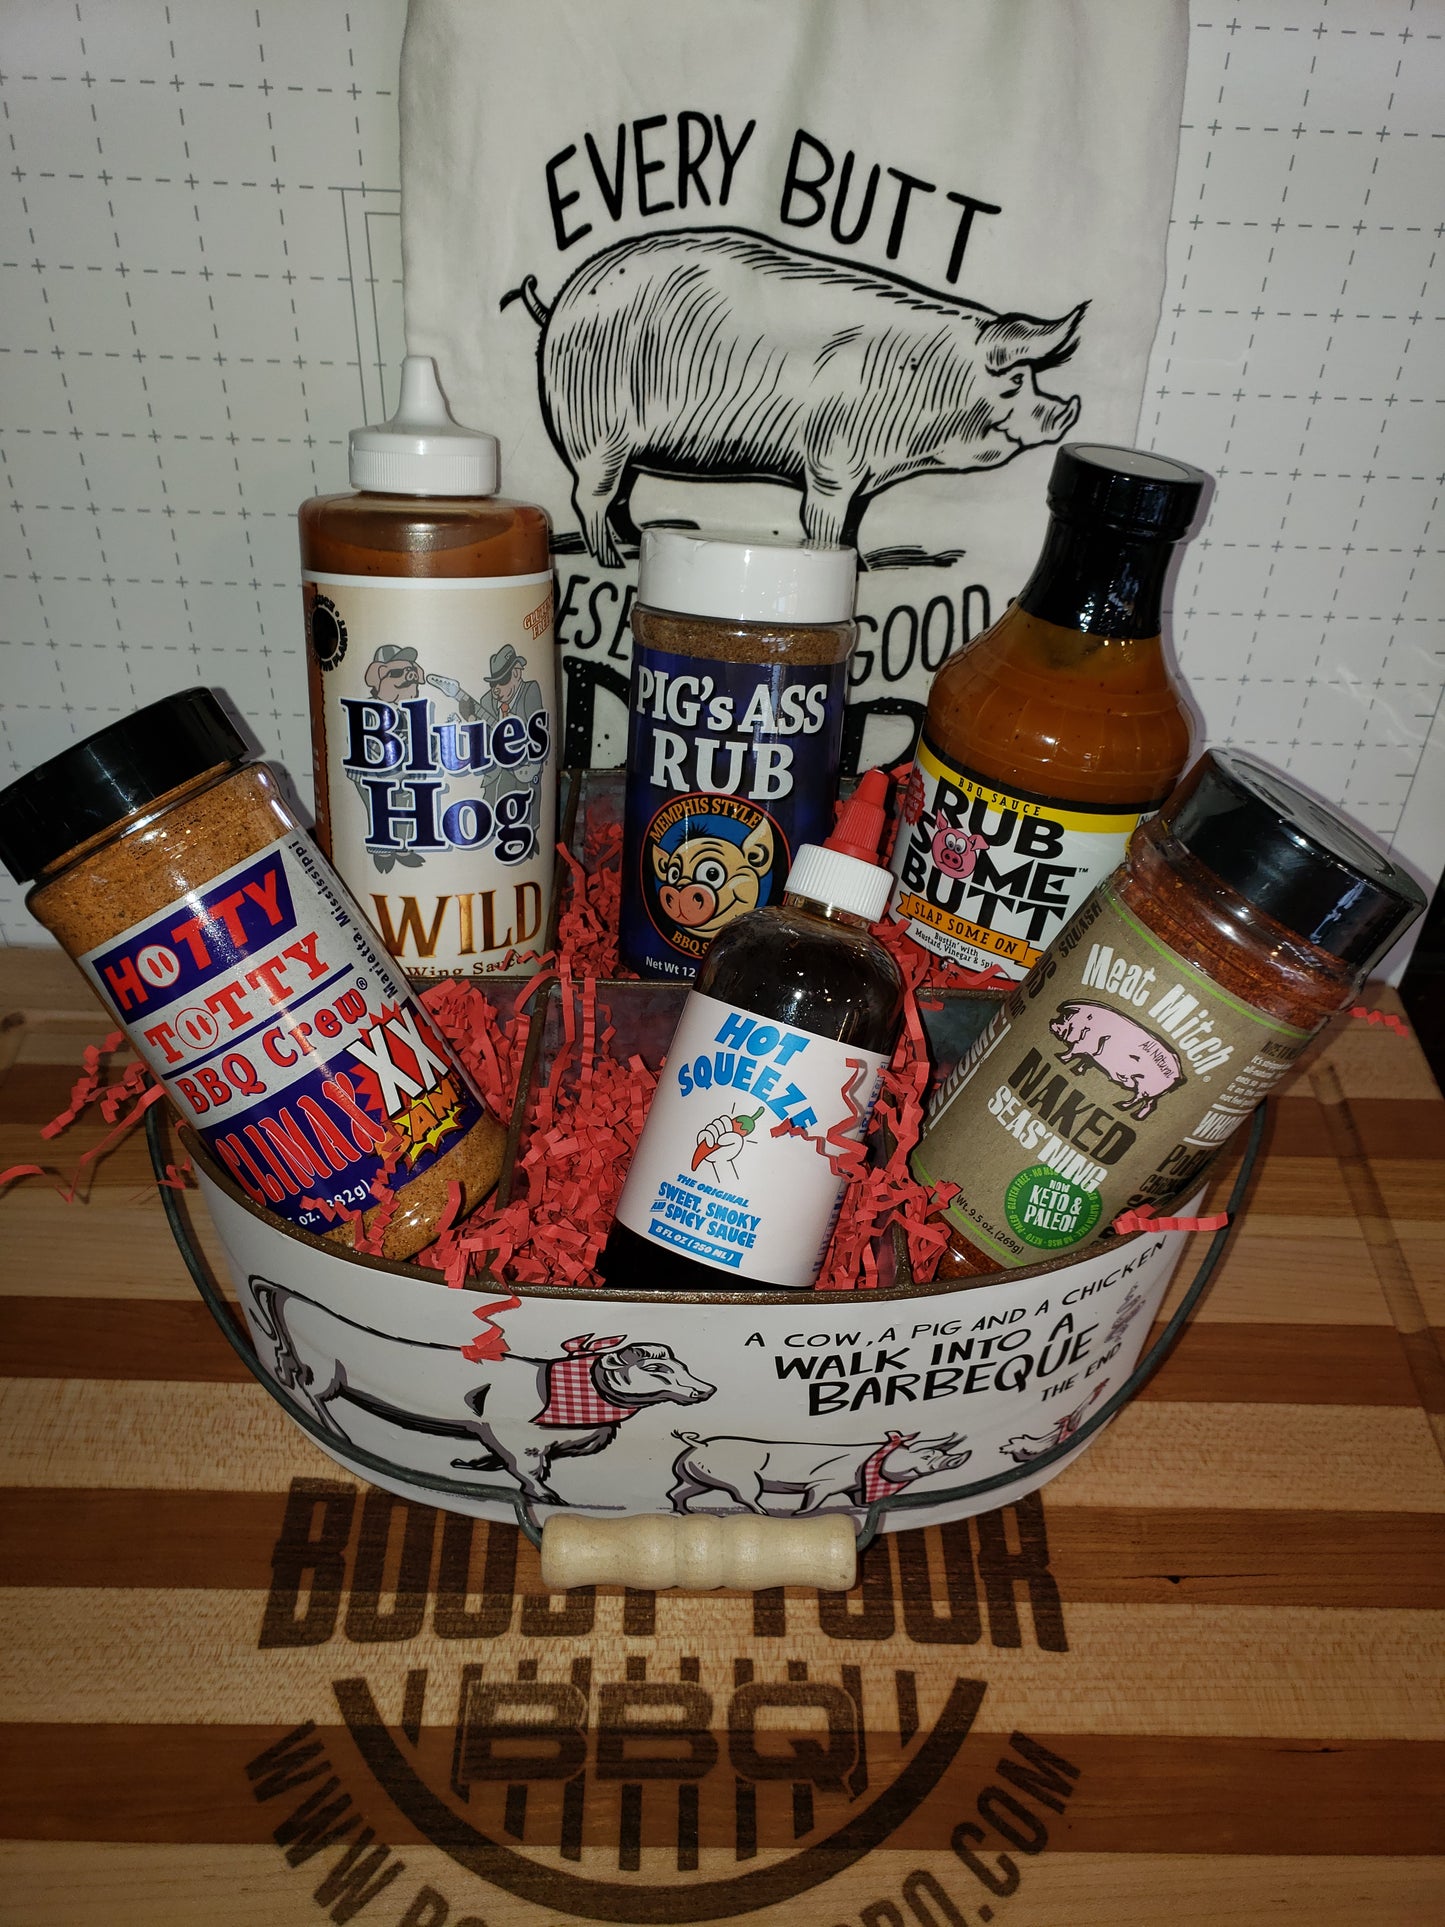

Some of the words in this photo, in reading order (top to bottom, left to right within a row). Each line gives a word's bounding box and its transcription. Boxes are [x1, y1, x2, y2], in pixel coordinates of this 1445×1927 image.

[545, 110, 756, 252] EVERY
[779, 129, 1002, 285] BUTT
[636, 665, 734, 730] PIG's
[737, 684, 828, 735] ASS
[340, 698, 549, 772] Blues
[650, 728, 794, 800] RUB
[361, 777, 534, 866] Hog
[650, 798, 709, 844] MEMPHIS
[711, 798, 763, 829] STYLE
[930, 776, 1065, 860] RUB
[958, 777, 983, 798] BBQ
[991, 793, 1041, 817] SAUCE
[288, 839, 351, 928] Mississippi
[900, 844, 1067, 942] BUTT
[104, 868, 286, 1012] HOTTY
[369, 881, 542, 958] WILD
[671, 930, 700, 953] BBQ
[914, 901, 943, 925] SLAP
[947, 915, 990, 946] SOME
[994, 935, 1019, 955] ON
[915, 928, 943, 950] Mustard,
[943, 944, 972, 964] Vinegar
[934, 932, 960, 949] Bustin'
[961, 942, 979, 957] with
[1060, 901, 1103, 957] SQUASH
[352, 926, 398, 1000] Marietta,
[645, 956, 662, 970] Net
[664, 962, 679, 975] Wt
[682, 966, 696, 978] 12
[144, 930, 331, 1065] TOTTY
[1082, 943, 1156, 1007] Meat
[1148, 982, 1234, 1075] Mitch
[714, 1012, 810, 1067] HOT
[1139, 1040, 1151, 1054] All
[1150, 1049, 1175, 1080] Natural
[174, 1052, 268, 1115] BBQ
[677, 1051, 818, 1138] SQUEEZE
[1007, 1047, 1138, 1166] NAKED
[214, 1071, 387, 1206] CLIMAX
[987, 1085, 1108, 1192] SEAS'NING
[658, 1182, 702, 1213] SWEET,
[705, 1202, 762, 1232] SMOKY
[677, 1173, 697, 1189] THE
[697, 1182, 750, 1208] ORIGINAL
[1016, 1172, 1031, 1188] FREE
[1029, 1184, 1070, 1212] KETO
[1070, 1197, 1083, 1215] &
[1049, 1179, 1071, 1193] NOW
[299, 1211, 321, 1226] oz.
[655, 1225, 662, 1233] 8
[662, 1228, 673, 1239] FL
[674, 1234, 688, 1245] OZ
[664, 1203, 707, 1231] SPICY
[706, 1221, 757, 1248] SAUCE
[956, 1195, 968, 1211] Wt.
[968, 1208, 984, 1222] 9.5
[982, 1222, 994, 1234] oz.
[994, 1230, 1025, 1255] (269g)
[1023, 1204, 1077, 1233] PALEO!
[743, 1331, 766, 1347] A
[877, 1327, 897, 1344] A
[911, 1318, 962, 1340] PIG
[970, 1306, 1027, 1333] AND
[1034, 1299, 1051, 1317] A
[1061, 1234, 1169, 1306] CHICKEN
[774, 1346, 909, 1381] WALK
[930, 1328, 1032, 1367] INTO
[1048, 1312, 1075, 1345] A
[808, 1322, 1100, 1418] BARBEQUE
[1040, 1375, 1075, 1403] THE
[1084, 1342, 1122, 1378] END
[453, 1680, 867, 1796] BBQ
